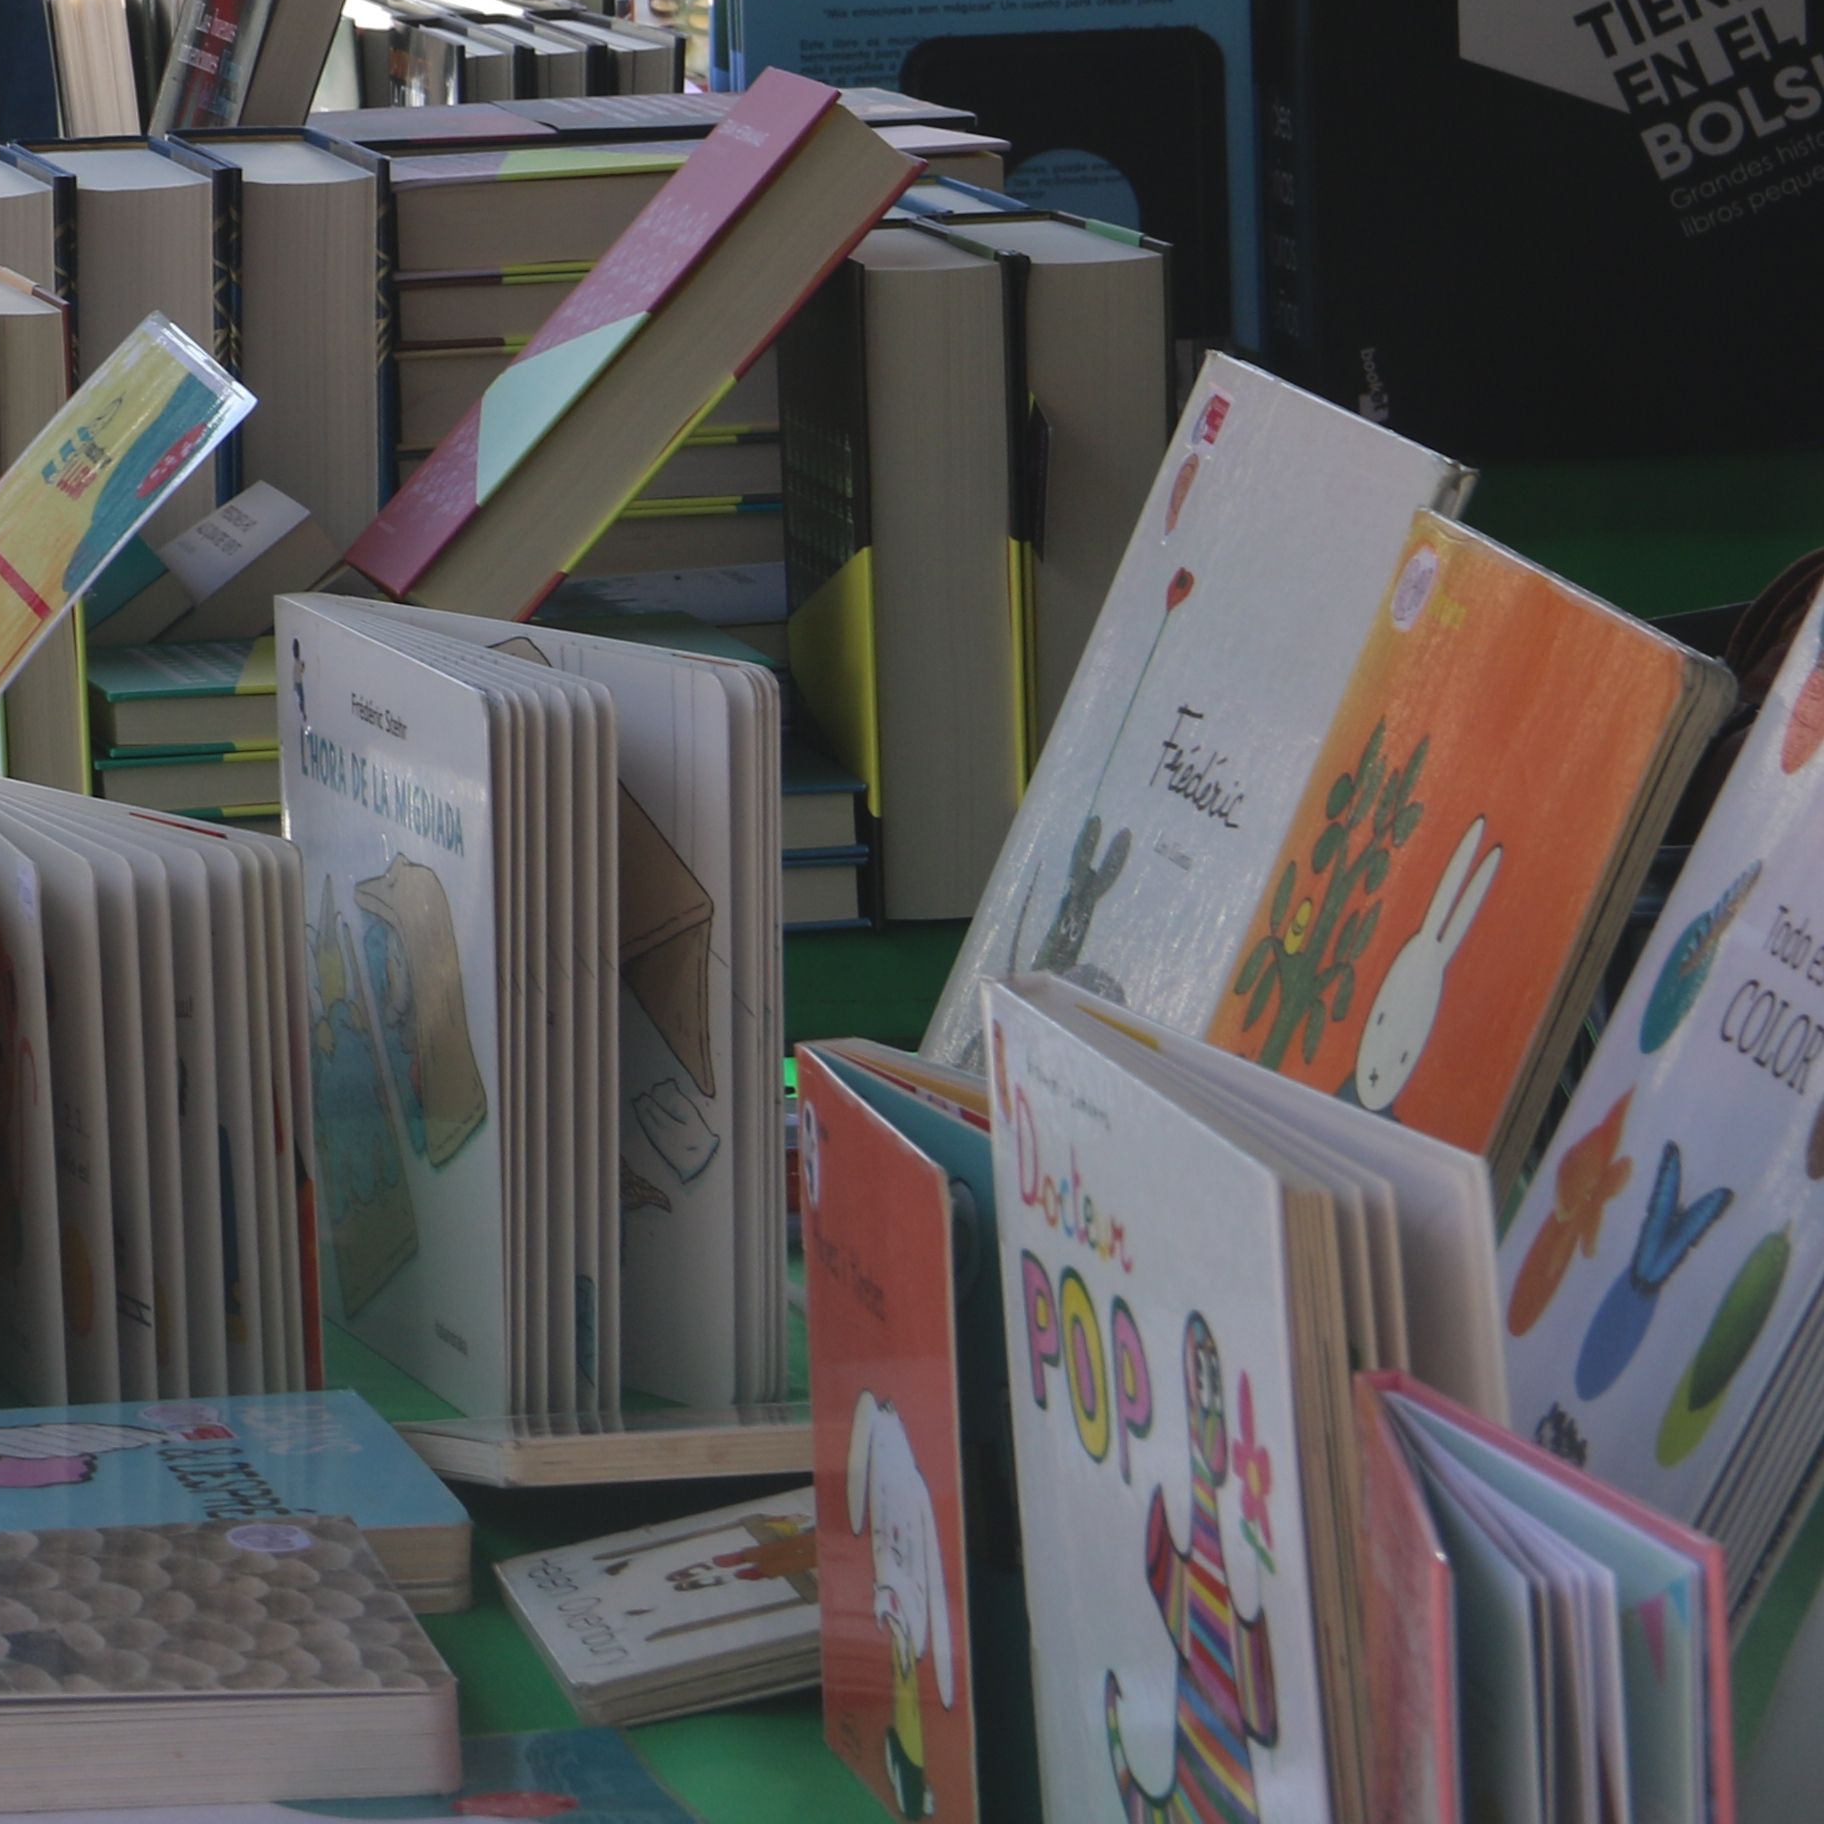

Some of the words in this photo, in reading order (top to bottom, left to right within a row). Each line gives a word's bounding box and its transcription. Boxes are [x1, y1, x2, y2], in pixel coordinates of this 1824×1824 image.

[1613, 38, 1710, 117] EN
[1714, 6, 1801, 66] EL
[1669, 153, 1775, 210] Grandes
[1679, 198, 1745, 239] libros
[301, 729, 347, 796] L'HORA
[351, 751, 369, 808] DE
[372, 764, 391, 819] LA
[394, 773, 465, 859] MIGDIADA
[1150, 704, 1245, 829] Frédéric
[1763, 904, 1813, 971] Todo
[1015, 1081, 1134, 1275] Docteur
[1021, 1248, 1153, 1486] POP
[156, 1446, 245, 1462] &
